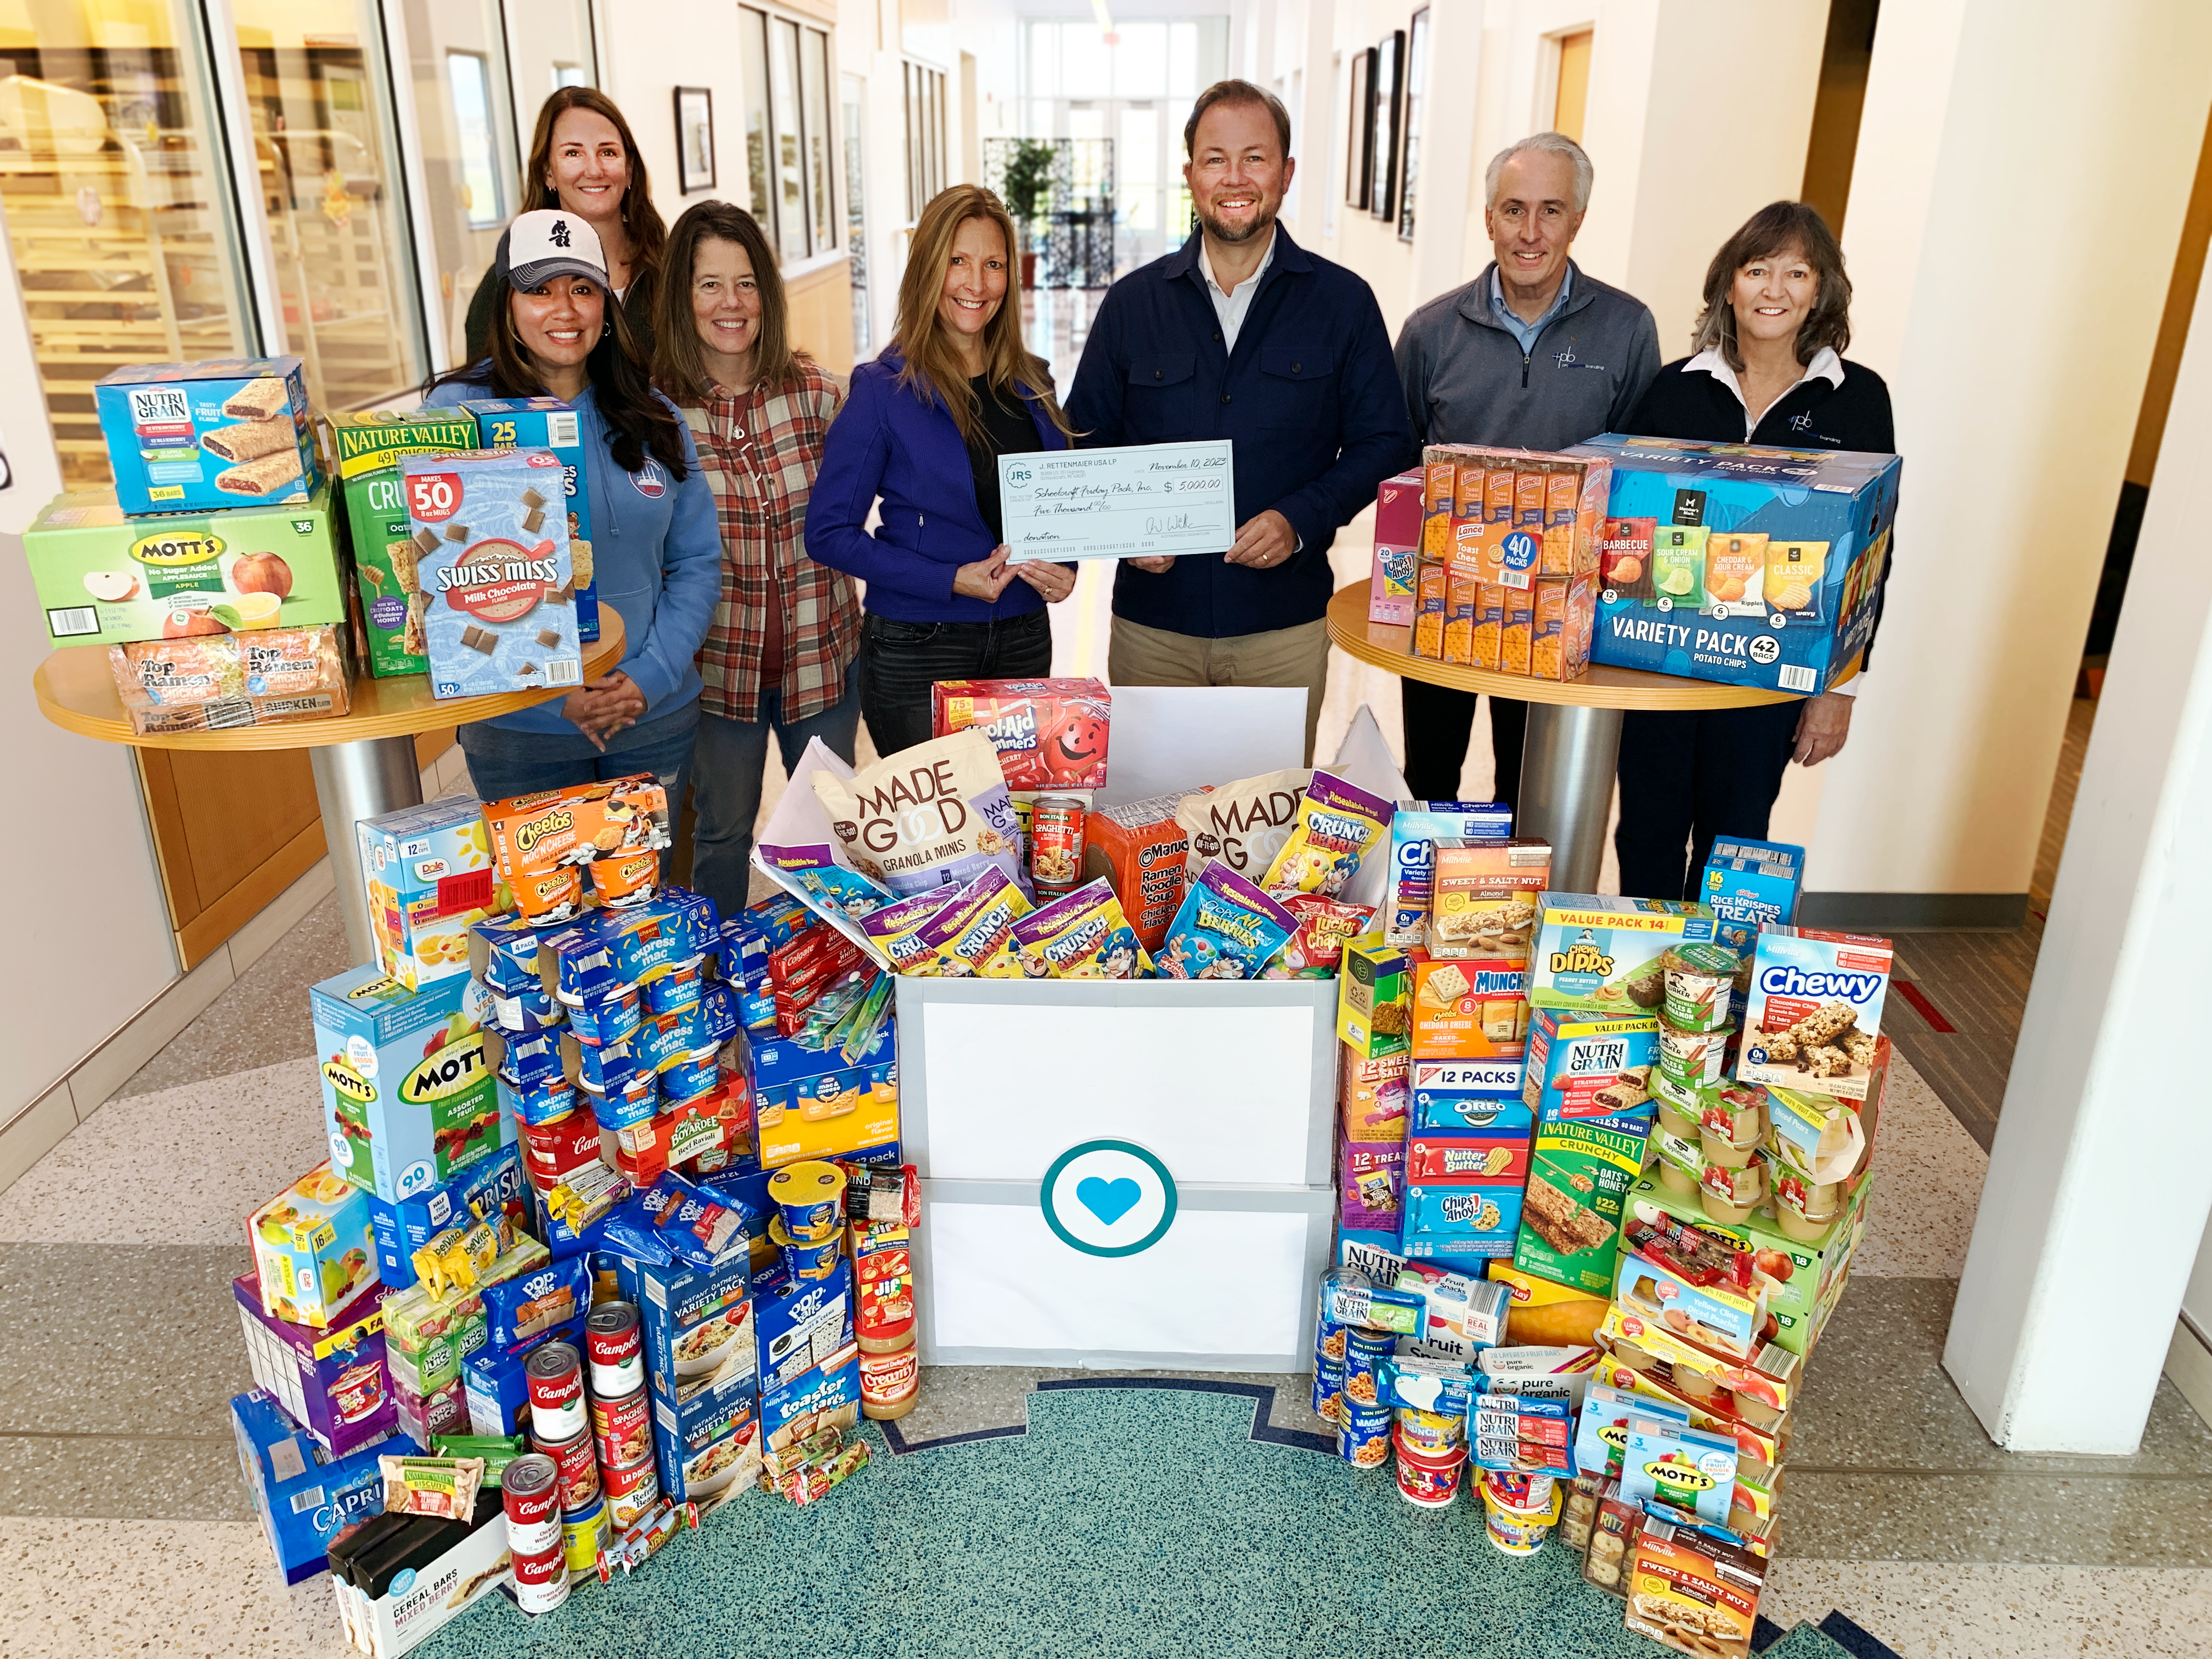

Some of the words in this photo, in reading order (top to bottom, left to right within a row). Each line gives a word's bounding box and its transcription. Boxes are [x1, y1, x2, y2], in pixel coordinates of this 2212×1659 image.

[136, 393, 183, 408] NUTRI
[138, 403, 185, 417] GRAIN
[195, 408, 221, 417] FRUIT
[491, 421, 516, 441] 25
[342, 427, 411, 457] NATURE
[413, 425, 471, 449] VALLEY
[1820, 435, 1841, 444] branding
[1047, 460, 1092, 469] RETTENMAIER
[1149, 460, 1188, 470] November
[1190, 459, 1200, 469] 10,
[1011, 471, 1032, 481] JRS
[153, 489, 165, 499] 36
[166, 488, 182, 498] BARS
[1035, 487, 1080, 500] Schoolcraft
[1080, 485, 1109, 499] Friday
[1137, 482, 1152, 492] Inc.
[1164, 481, 1172, 493] $
[1179, 479, 1221, 492] 5,000.00
[414, 483, 453, 509] 50
[1034, 505, 1051, 516] Five
[1053, 503, 1093, 514] Thousand
[1679, 506, 1699, 514] Member's
[296, 522, 312, 532] 36
[1458, 526, 1484, 537] Lance
[1024, 533, 1060, 541] donation
[1603, 539, 1648, 550] BARBECUE
[1457, 545, 1479, 555] Toast
[1508, 535, 1530, 556] 40
[1506, 556, 1528, 568] PACKS
[162, 573, 207, 581] APPLESAUCE
[437, 563, 501, 592] SWISS
[505, 558, 558, 582] MISS
[1774, 565, 1814, 576] CLASSIC
[464, 592, 487, 604] Milk
[487, 581, 537, 600] Chocolate
[1612, 616, 1691, 646] VARIETY
[1696, 629, 1748, 657] PACK
[1753, 640, 1776, 653] 42
[250, 647, 282, 662] Top
[1694, 653, 1722, 665] POTATO
[1724, 657, 1747, 669] CHIPS
[1752, 651, 1774, 661] BAGS
[250, 658, 315, 674] Ramen
[952, 700, 967, 709] 75
[856, 759, 958, 820] MADE
[1329, 791, 1365, 811] Resealable
[1365, 807, 1378, 816] Bag!
[517, 811, 573, 851] Cheetos
[862, 798, 967, 853] GOOD
[1035, 823, 1075, 835] SPAGHETTI
[1309, 812, 1373, 844] CRUNCH
[546, 831, 577, 850] CHEESE
[408, 844, 418, 855] 12
[883, 850, 933, 872] GRANOLA
[934, 839, 966, 860] MINIS
[422, 861, 444, 876] Dole
[1142, 865, 1182, 882] Ramen
[1141, 876, 1182, 895] Noodle
[1442, 878, 1477, 886] SWEET
[1146, 890, 1174, 906] Soup
[1480, 889, 1504, 898] Almond
[1140, 903, 1177, 921] Chicken
[1143, 913, 1172, 930] Flavor
[1560, 913, 1596, 926] VALUE
[1599, 916, 1643, 928] PACK
[1197, 911, 1260, 949] BERRIES
[521, 940, 535, 950] PACK
[630, 938, 676, 962] express
[642, 950, 668, 966] mac
[787, 944, 815, 967] Colgate
[1550, 953, 1614, 977] DIPPS
[1559, 976, 1576, 984] PEANUT
[1760, 966, 1881, 1004] Chewy
[1770, 998, 1801, 1009] Chocolate
[1803, 1002, 1816, 1011] Chip
[1420, 1021, 1448, 1030] CHEDDAR
[1449, 1021, 1472, 1029] CHEESE
[1441, 1071, 1457, 1084] 12
[1462, 1071, 1516, 1084] PACKS
[447, 1094, 484, 1117] ASSORTED
[458, 1105, 475, 1119] FRUIT
[1454, 1101, 1506, 1114] OREO
[671, 1116, 719, 1147] BOYARDEE
[865, 1118, 893, 1130] original
[871, 1124, 894, 1135] flavor
[678, 1141, 692, 1156] Beef
[693, 1133, 715, 1147] Ravioli
[1559, 1140, 1620, 1161] CRUNCHY
[1444, 1150, 1486, 1161] Nutter
[1446, 1160, 1487, 1172] Butter
[403, 1167, 425, 1189] 90
[1599, 1168, 1621, 1181] OATS
[408, 1178, 427, 1195] COUNT
[1598, 1177, 1627, 1192] HONEY
[1793, 1256, 1808, 1266] 18
[874, 1278, 900, 1296] Jif
[1439, 1282, 1467, 1295] Snacks
[1445, 1278, 1465, 1288] Fruit
[674, 1288, 717, 1318] VARIETY
[719, 1276, 746, 1299] PACK
[1688, 1305, 1707, 1319] Diced
[1709, 1312, 1741, 1331] Peaches
[1694, 1298, 1718, 1314] Yellow
[1720, 1308, 1740, 1323] Cling
[866, 1364, 913, 1385] Creamy
[1522, 1378, 1553, 1390] pure
[780, 1375, 847, 1419] toaster
[811, 1391, 846, 1413] tarts
[414, 1480, 447, 1490] BISCUITS
[313, 1488, 381, 1532] CAPRI
[1600, 1513, 1626, 1532] RITZ
[1642, 1540, 1676, 1559] Millville
[393, 1587, 431, 1618] CEREAL
[433, 1568, 458, 1592] BARS
[394, 1605, 426, 1628] MIXED
[428, 1578, 458, 1607] BERRY
